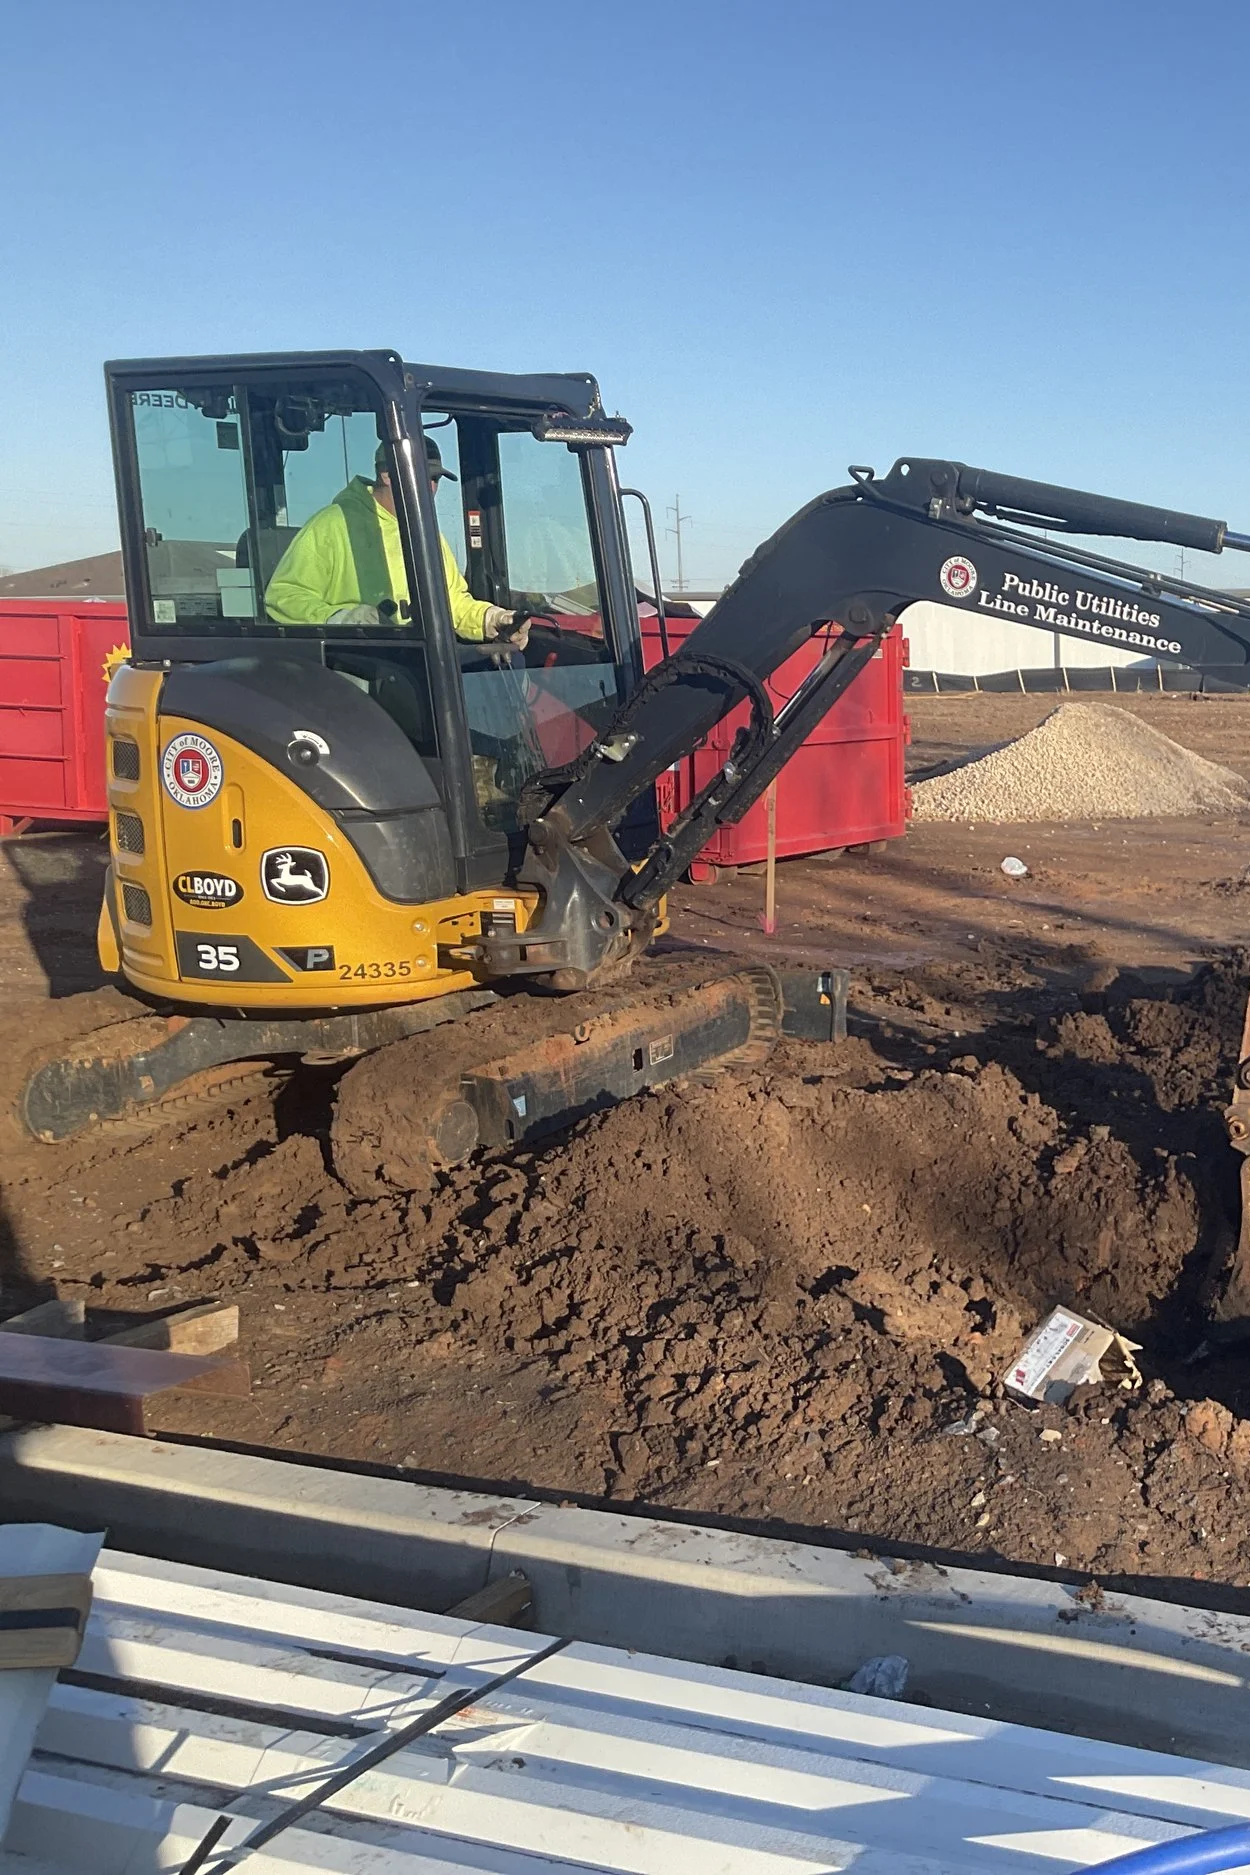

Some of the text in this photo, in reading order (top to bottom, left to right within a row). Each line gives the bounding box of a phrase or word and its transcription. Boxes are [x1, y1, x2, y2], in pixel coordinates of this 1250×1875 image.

[942, 560, 953, 574] CITY
[1001, 573, 1161, 628] Public Utilities
[977, 590, 1183, 654] Line Maintenance
[911, 676, 922, 688] 2
[165, 737, 220, 773] CITY of MOORE
[168, 781, 218, 806] OKLAHOMA
[197, 944, 240, 972] 35
[306, 948, 330, 969] P
[339, 961, 412, 980] 24335
